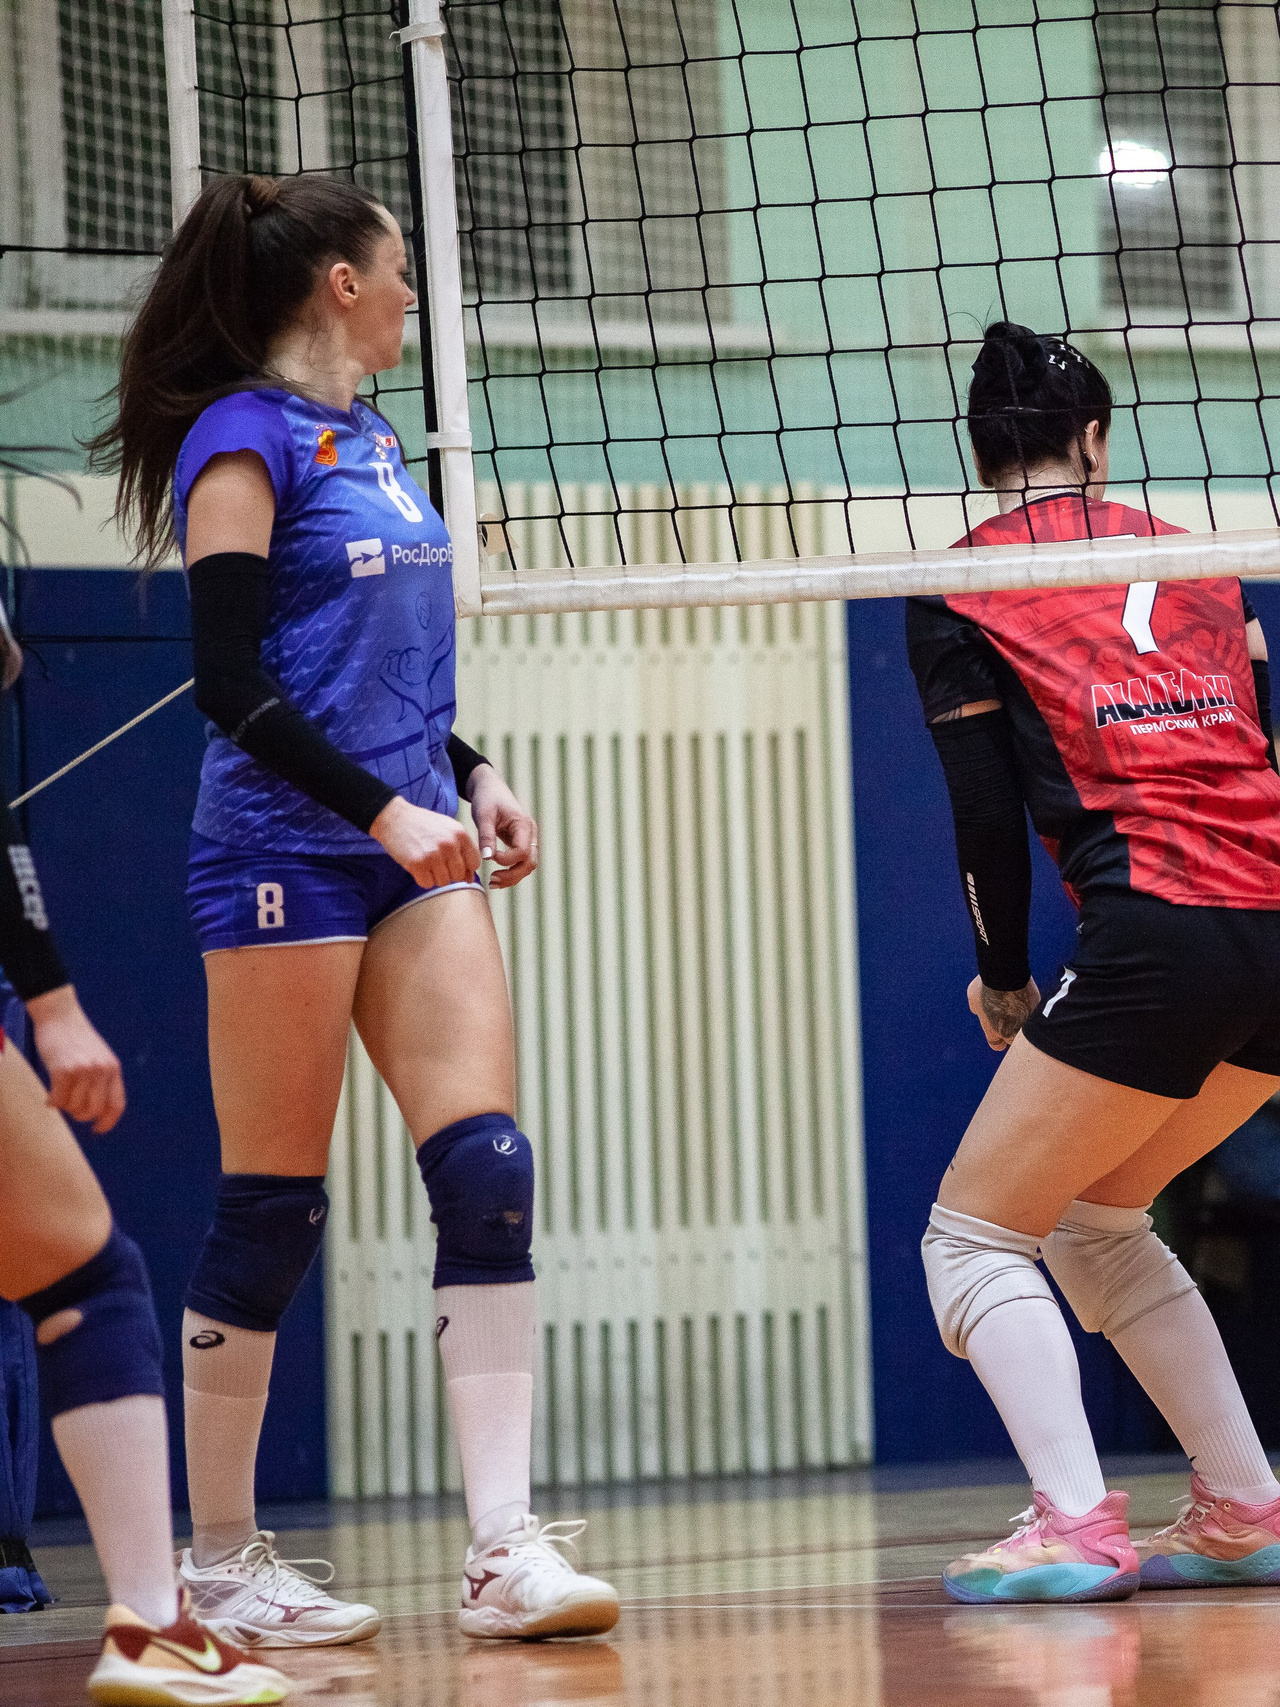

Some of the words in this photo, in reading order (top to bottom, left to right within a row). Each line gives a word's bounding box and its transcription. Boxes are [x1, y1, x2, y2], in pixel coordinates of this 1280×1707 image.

[368, 461, 424, 524] 8
[1130, 715, 1199, 735] ПЕРМСКИЙ
[1201, 708, 1236, 727] КРАЙ
[257, 882, 285, 929] 8
[1042, 965, 1077, 1018] 7
